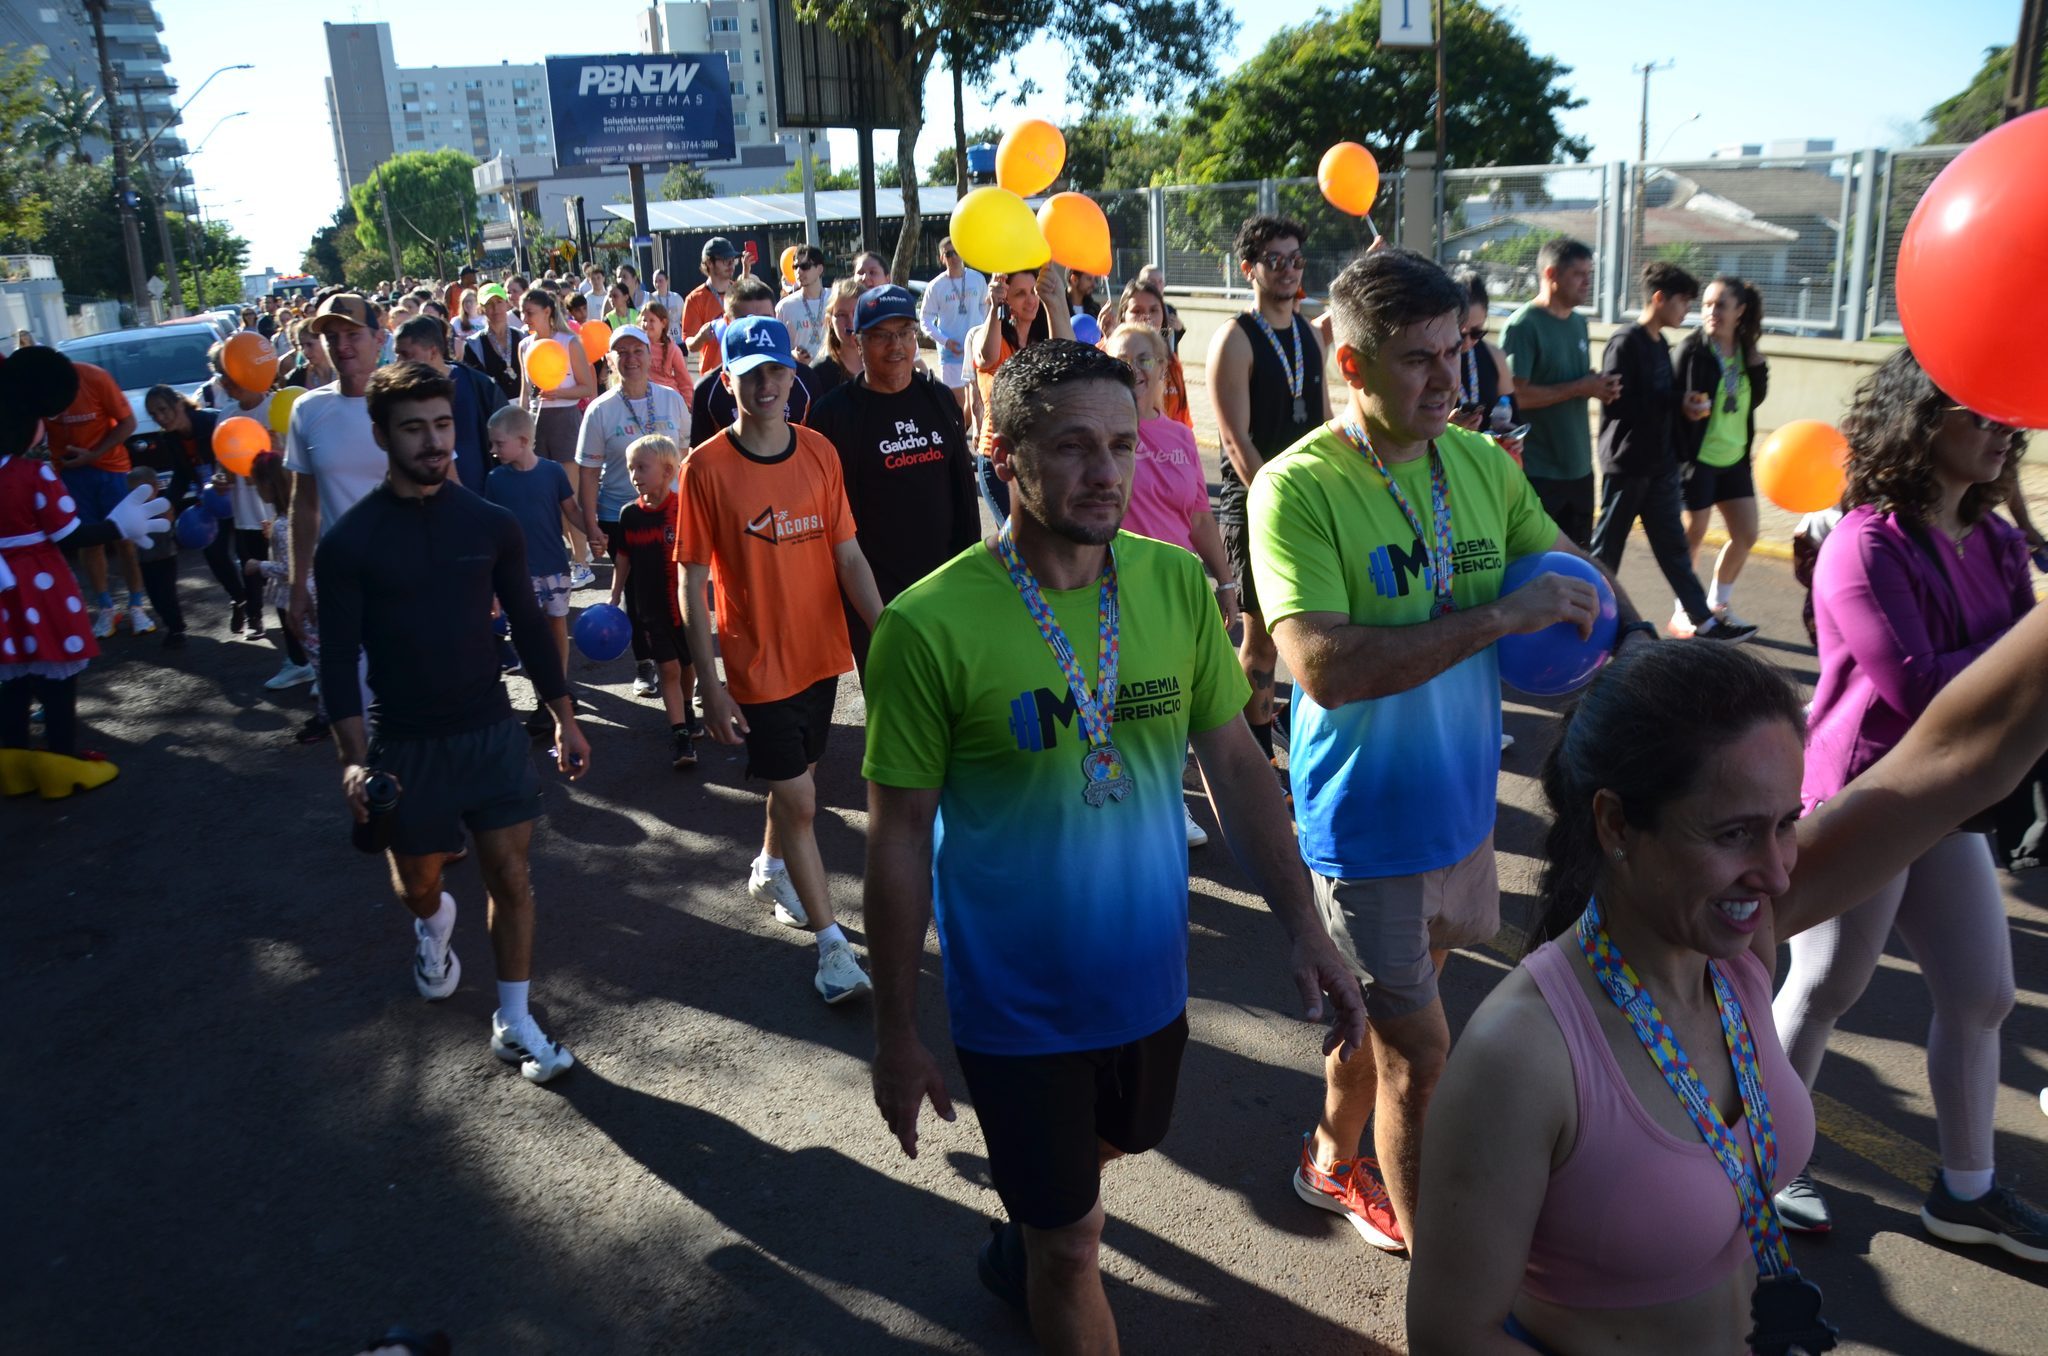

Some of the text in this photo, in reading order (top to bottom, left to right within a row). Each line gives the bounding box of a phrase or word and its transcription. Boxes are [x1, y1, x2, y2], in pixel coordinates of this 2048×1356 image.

[578, 62, 700, 96] PBNEW
[610, 94, 703, 108] SISTEMAS
[603, 113, 684, 126] Soluções tecnológicas
[617, 125, 649, 134] produtos
[656, 124, 685, 132] serviços.
[743, 325, 776, 348] LA
[895, 418, 919, 435] Pai,
[879, 430, 943, 454] Gaúcho &
[885, 447, 944, 469] Colorado.
[1452, 537, 1498, 556] DEMIA
[1452, 556, 1503, 575] RENCIO
[1113, 698, 1181, 723] ERENCIO
